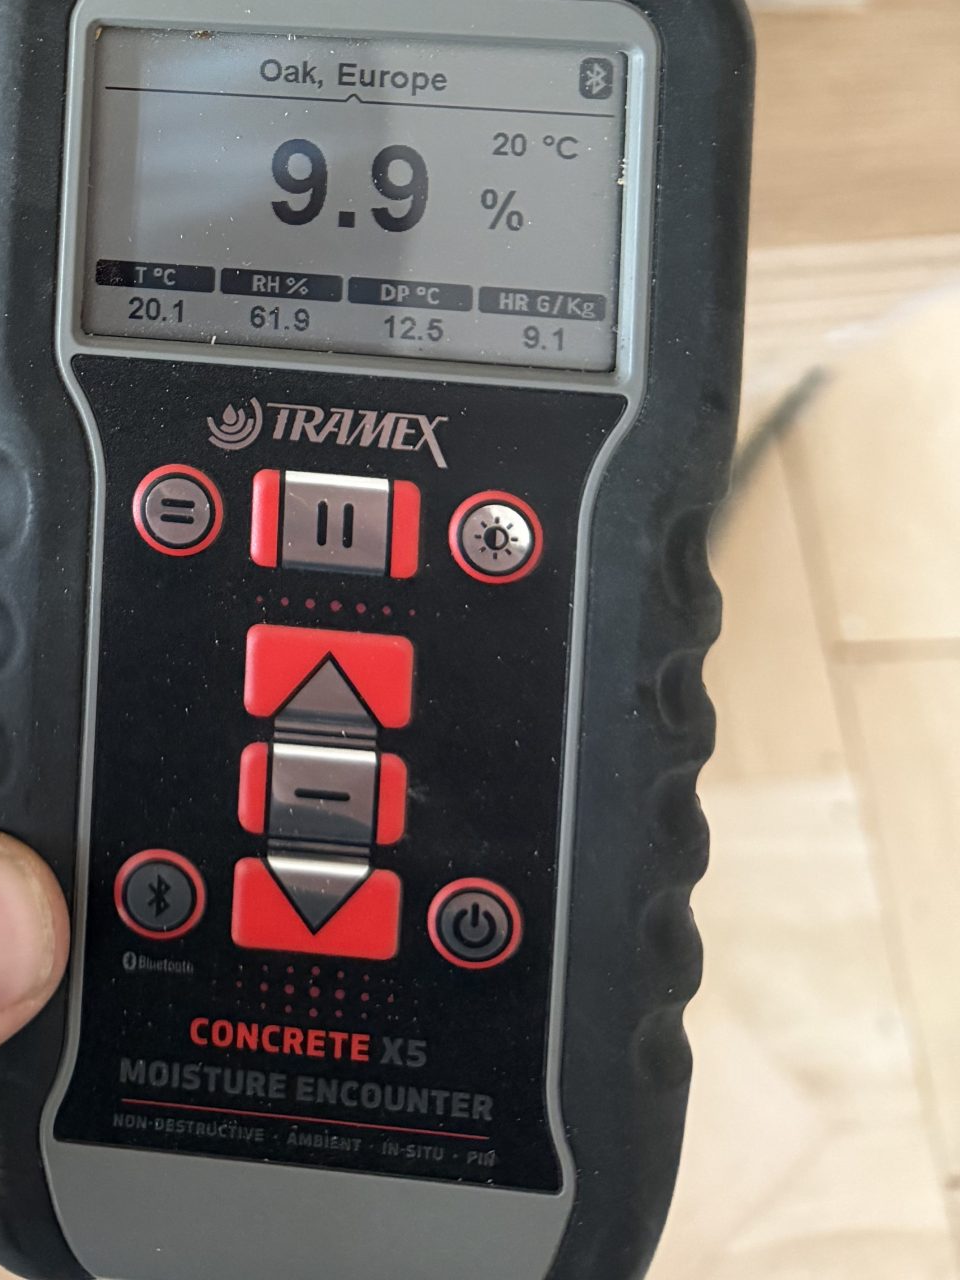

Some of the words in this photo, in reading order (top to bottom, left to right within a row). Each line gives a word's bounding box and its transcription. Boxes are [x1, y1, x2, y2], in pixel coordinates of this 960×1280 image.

[259, 58, 324, 89] Oak,
[337, 62, 448, 95] Europe
[492, 132, 527, 158] 20
[542, 134, 579, 161] °C
[270, 138, 430, 233] 9.9
[480, 188, 525, 232] %
[133, 266, 147, 285] T
[251, 274, 280, 294] RH
[285, 276, 310, 297] %
[380, 283, 411, 304] DP
[499, 292, 529, 313] HR
[536, 294, 596, 320] G/Kg
[128, 296, 186, 324] 20.1
[248, 304, 311, 333] 61.9
[383, 316, 444, 343] 12.5
[523, 326, 566, 352] 9.1
[265, 402, 449, 469] TRAMEX
[138, 955, 195, 975] Bluetooth
[189, 1016, 370, 1063] CONCRETE
[379, 1035, 428, 1068] X5
[119, 1057, 287, 1101] MOISTURE
[295, 1075, 494, 1122] ENCOUNTER
[112, 1113, 265, 1143] NON-DESTRUCTIVE
[286, 1130, 362, 1153] AMBIENT
[381, 1140, 445, 1162] IN-SITU
[466, 1150, 496, 1168] PIN
